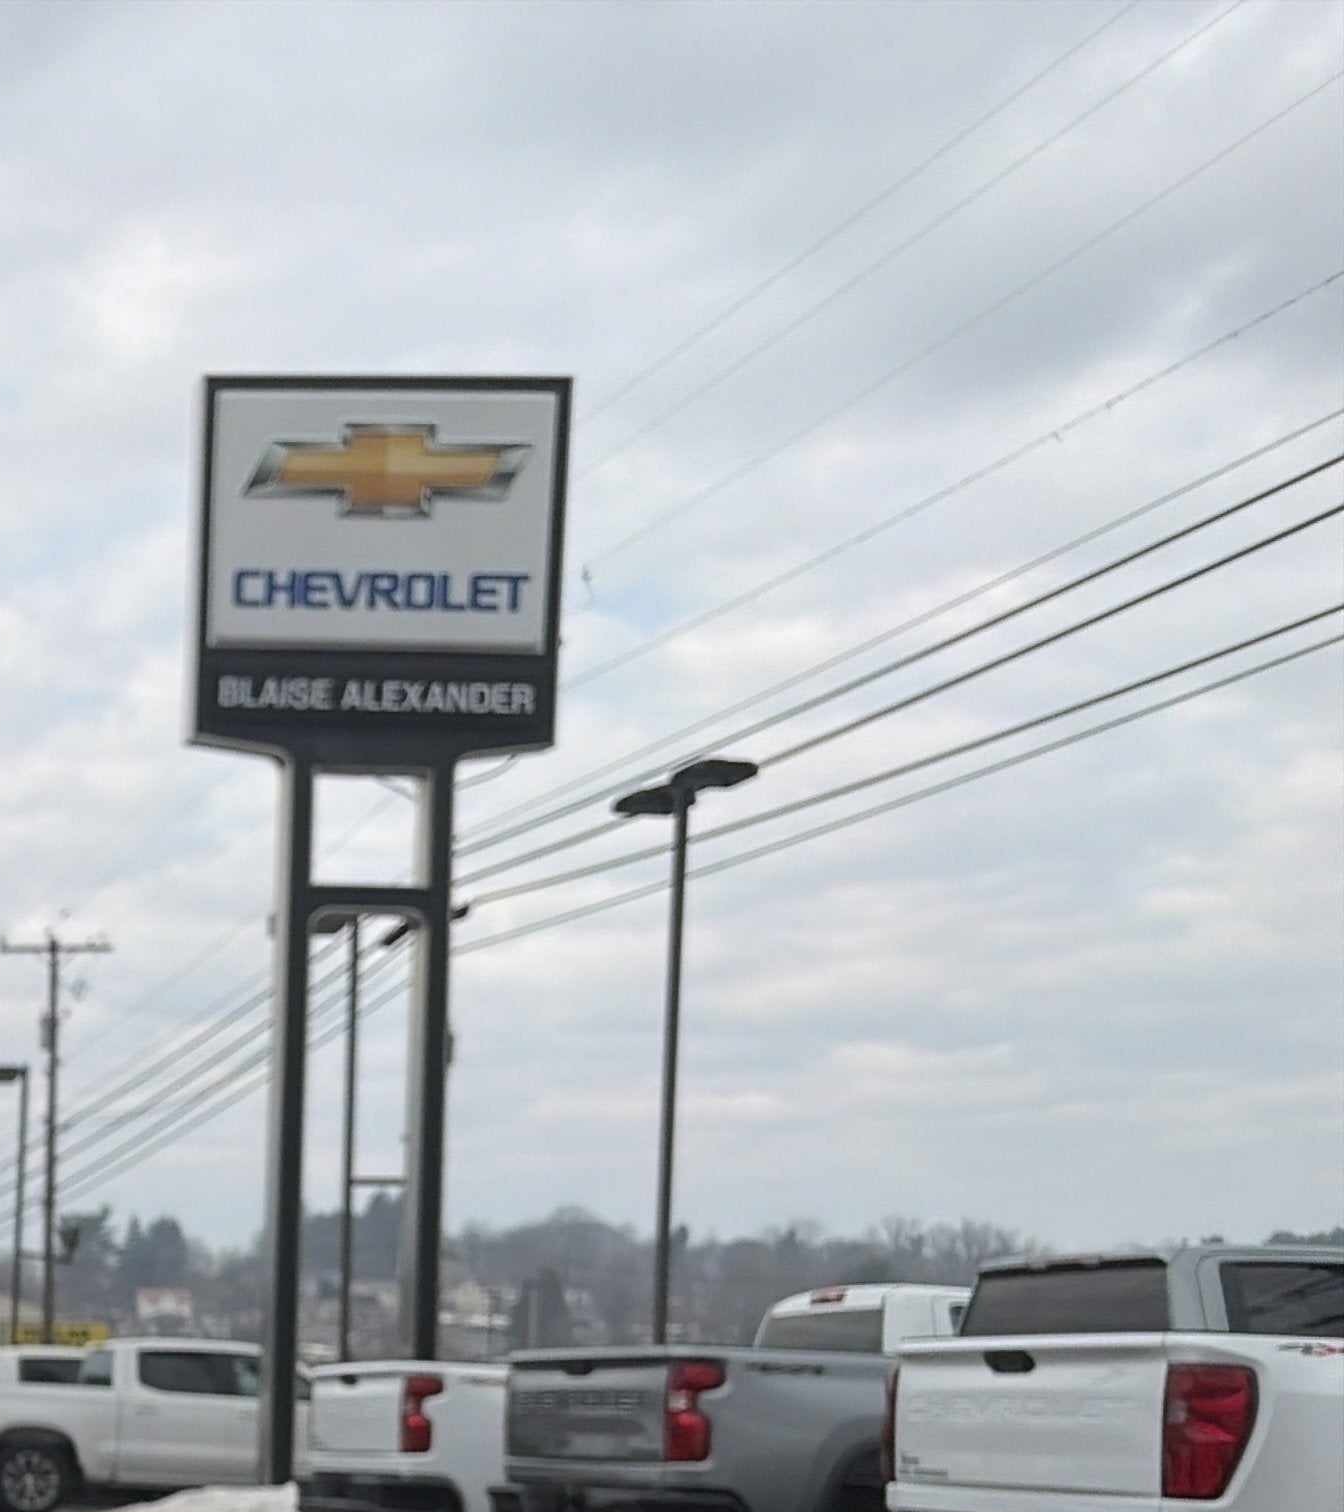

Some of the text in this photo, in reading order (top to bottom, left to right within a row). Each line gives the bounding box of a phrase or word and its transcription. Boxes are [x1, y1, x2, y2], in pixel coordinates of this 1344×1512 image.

[233, 567, 529, 614] CHEVROLET
[218, 674, 536, 715] BLAISE ALEXANDER
